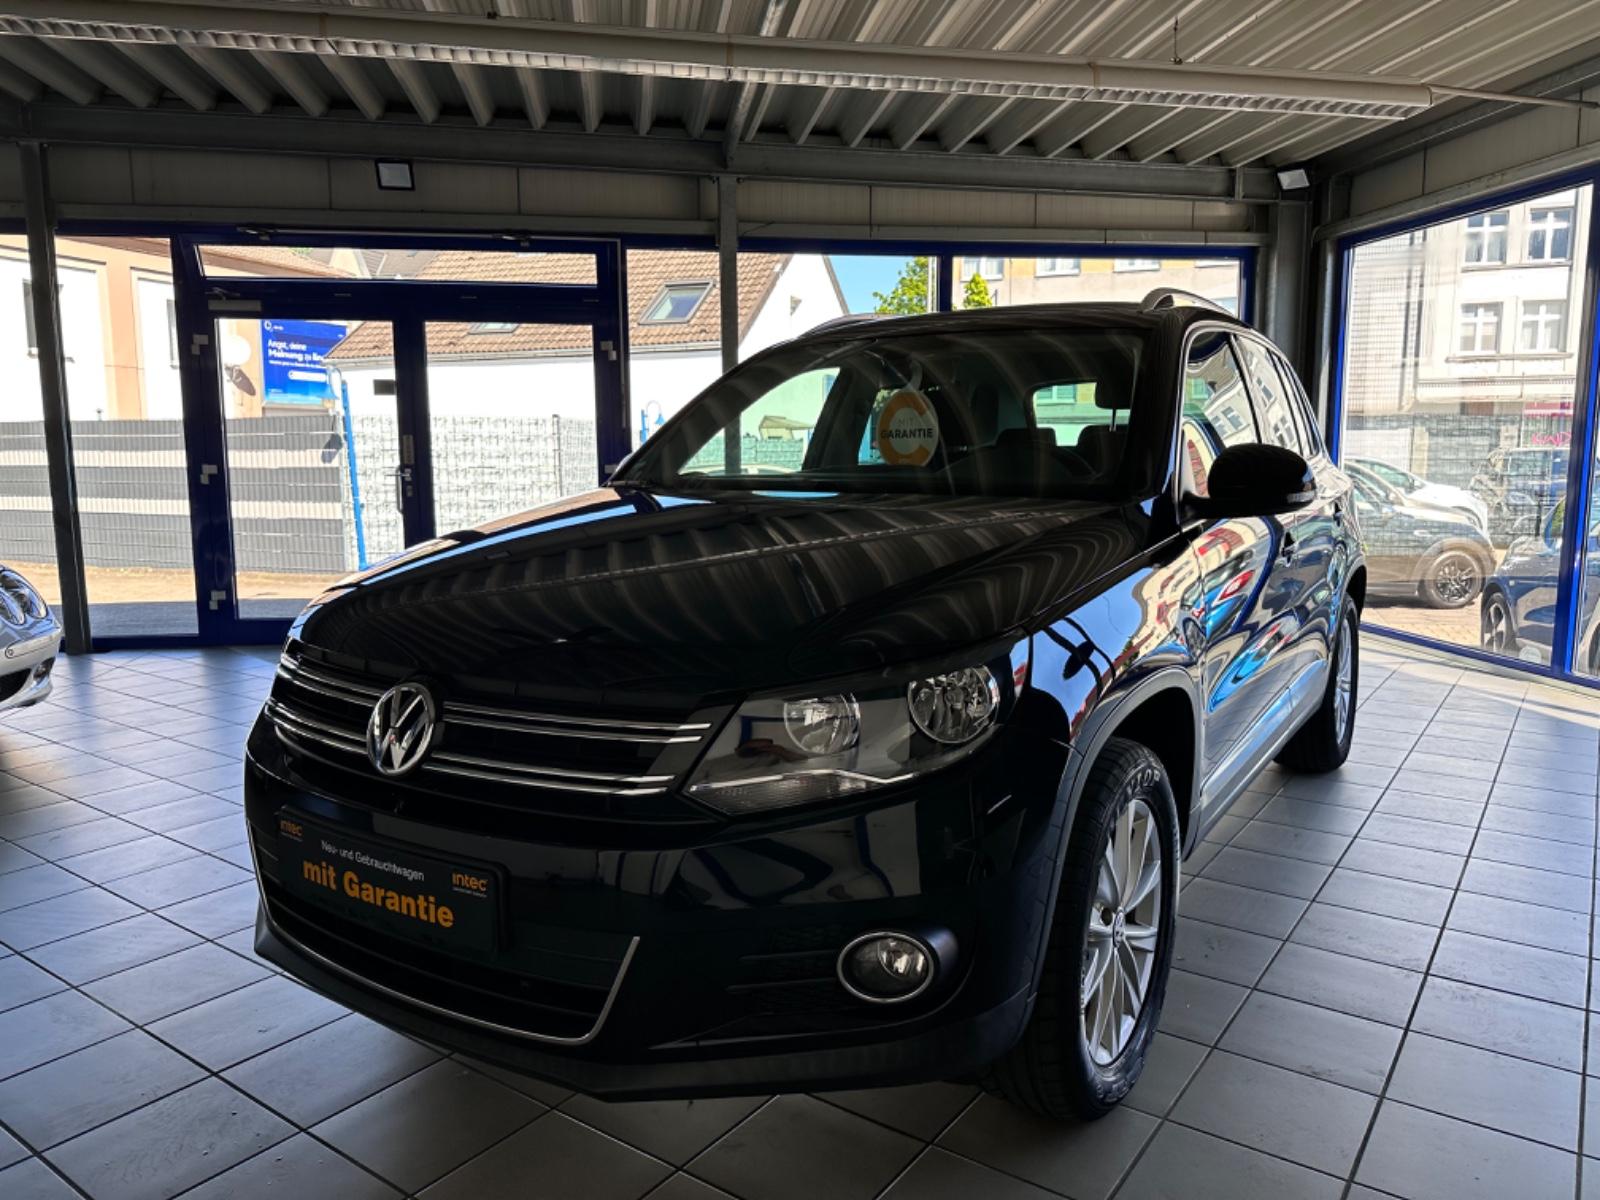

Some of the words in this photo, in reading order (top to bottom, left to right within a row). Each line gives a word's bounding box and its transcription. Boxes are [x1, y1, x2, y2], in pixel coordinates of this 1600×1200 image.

[289, 342, 307, 351] deine
[268, 349, 303, 362] Meinung
[880, 427, 934, 440] GARANTIE
[339, 846, 354, 861] und
[354, 851, 425, 882] Gebrauchtwagen
[451, 871, 488, 892] intec
[303, 859, 338, 891] mit
[342, 870, 455, 929] Garantie
